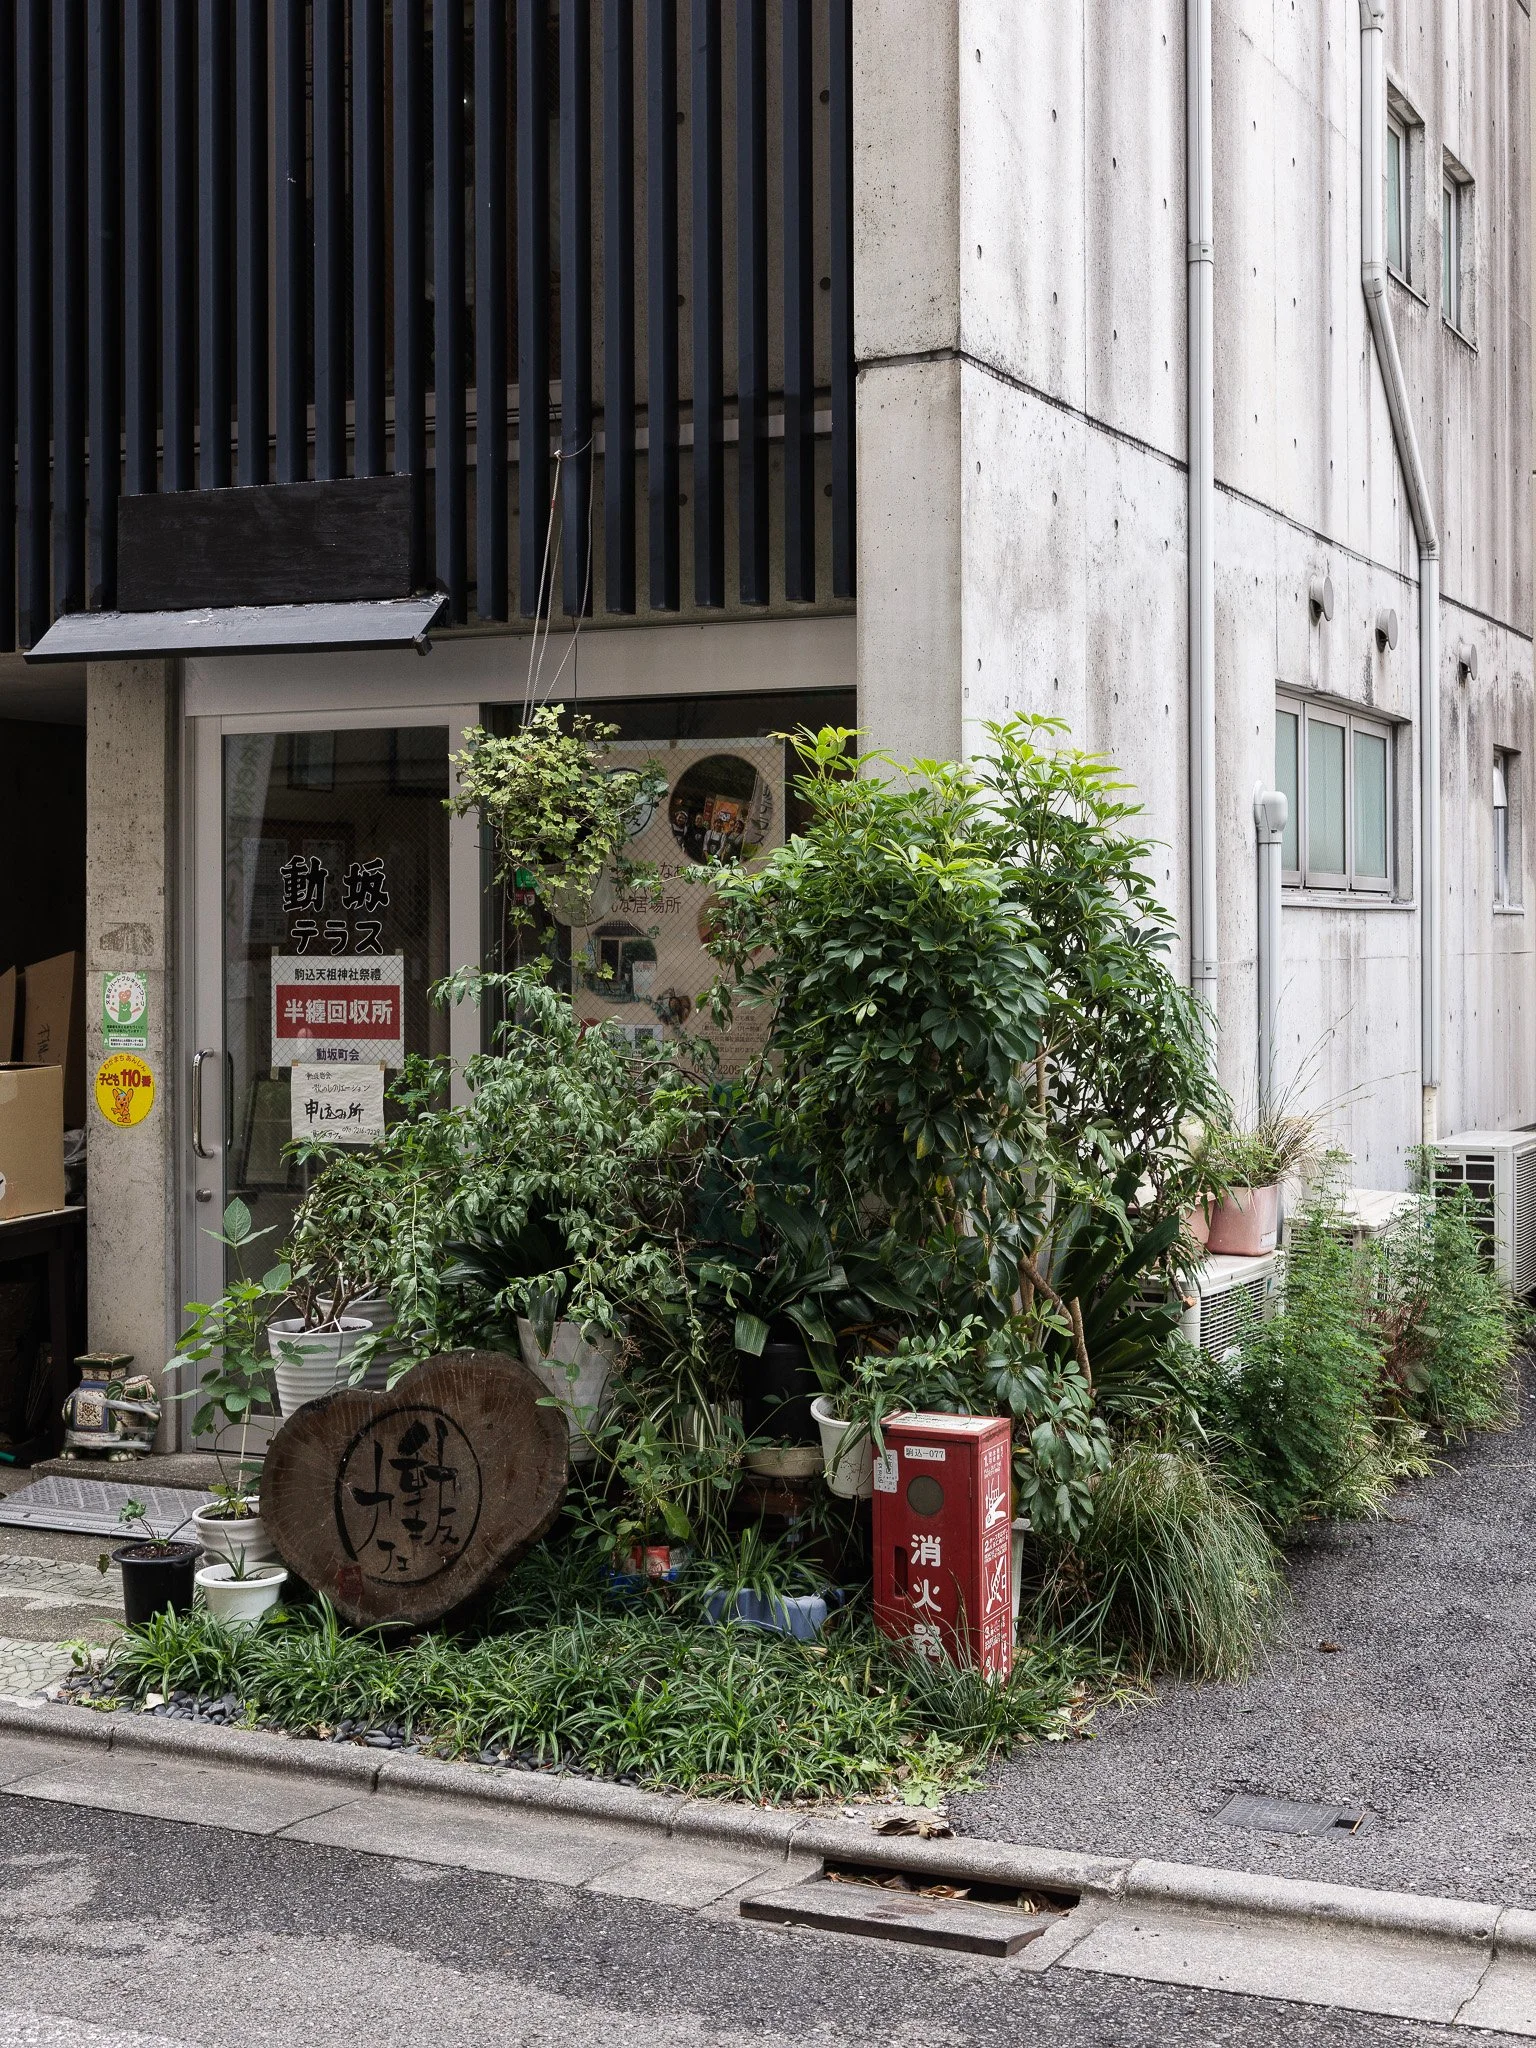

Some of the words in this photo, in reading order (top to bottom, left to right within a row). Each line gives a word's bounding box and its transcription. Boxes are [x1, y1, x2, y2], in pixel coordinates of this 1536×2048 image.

[279, 854, 390, 914] 動坂
[289, 918, 385, 956] テラス
[295, 968, 382, 981] 駒込天祖神社祭禮
[284, 998, 393, 1025] 半纏回収所
[316, 1048, 360, 1061] 動坂町会
[304, 1099, 364, 1123] 申し込み所
[911, 1534, 942, 1657] 消火器
